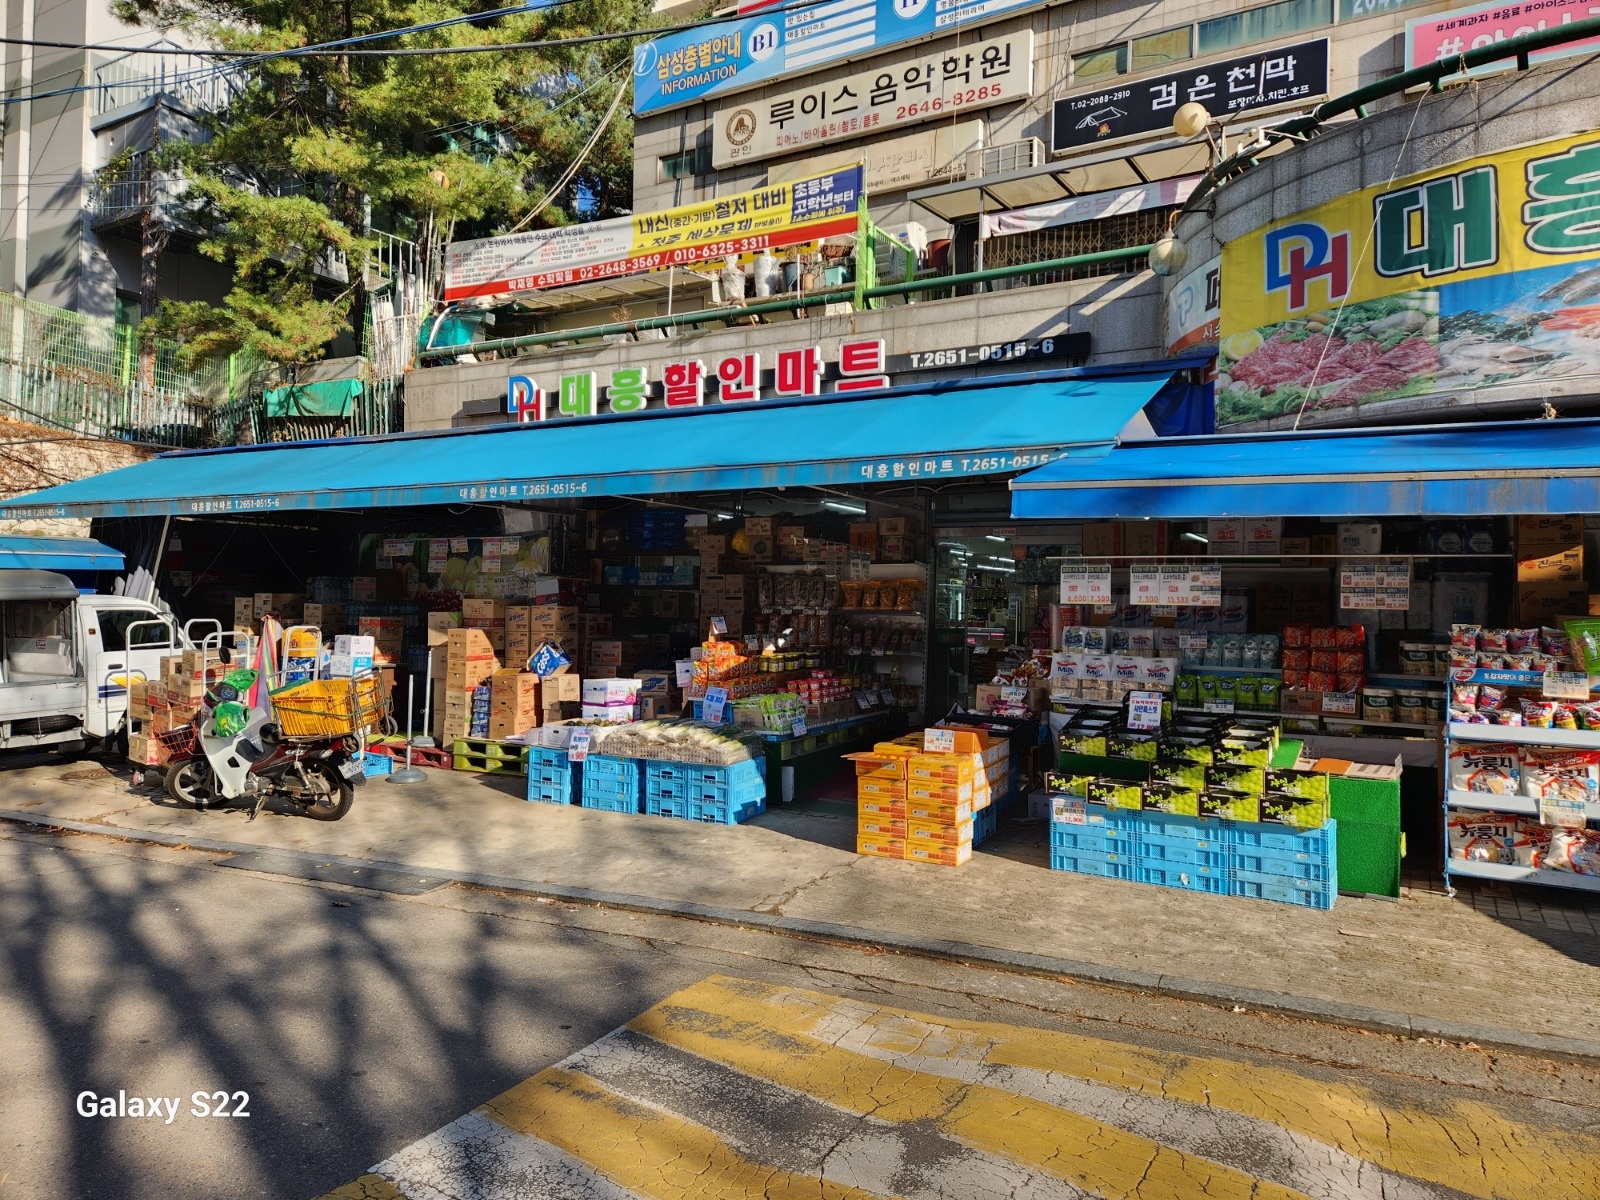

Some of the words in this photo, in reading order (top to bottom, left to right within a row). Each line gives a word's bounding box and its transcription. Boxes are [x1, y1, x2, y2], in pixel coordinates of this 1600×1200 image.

[1436, 14, 1489, 32] #세계과자
[1492, 7, 1521, 21] #음료
[752, 30, 775, 53] B1
[656, 30, 743, 81] 삼성층별안내
[661, 63, 738, 96] INFORMATION
[769, 85, 859, 130] 루이스
[869, 42, 1012, 107] 음악학원
[896, 83, 1002, 120] 2646-8285
[1070, 90, 1131, 110] T.02-2088-2910
[730, 144, 752, 158] 관인
[753, 186, 787, 210] 대비
[794, 175, 834, 199] 초등부
[794, 189, 854, 214] 고학년부터
[538, 270, 573, 287] 수학학원
[579, 253, 661, 279] 02-2648-3569
[673, 234, 770, 261] 010-6325-3311
[910, 338, 1055, 368] T.2651-0515~6
[558, 337, 891, 417] 대흥할인마트
[861, 459, 954, 479] 대흥할인마트
[459, 486, 518, 499] 대흥할인마트
[522, 482, 587, 496] T.2651-0515~6
[191, 501, 232, 512] 대흥할인마트
[1057, 666, 1074, 674] Milk
[1117, 669, 1135, 677] Milk
[1148, 671, 1167, 679] Milk
